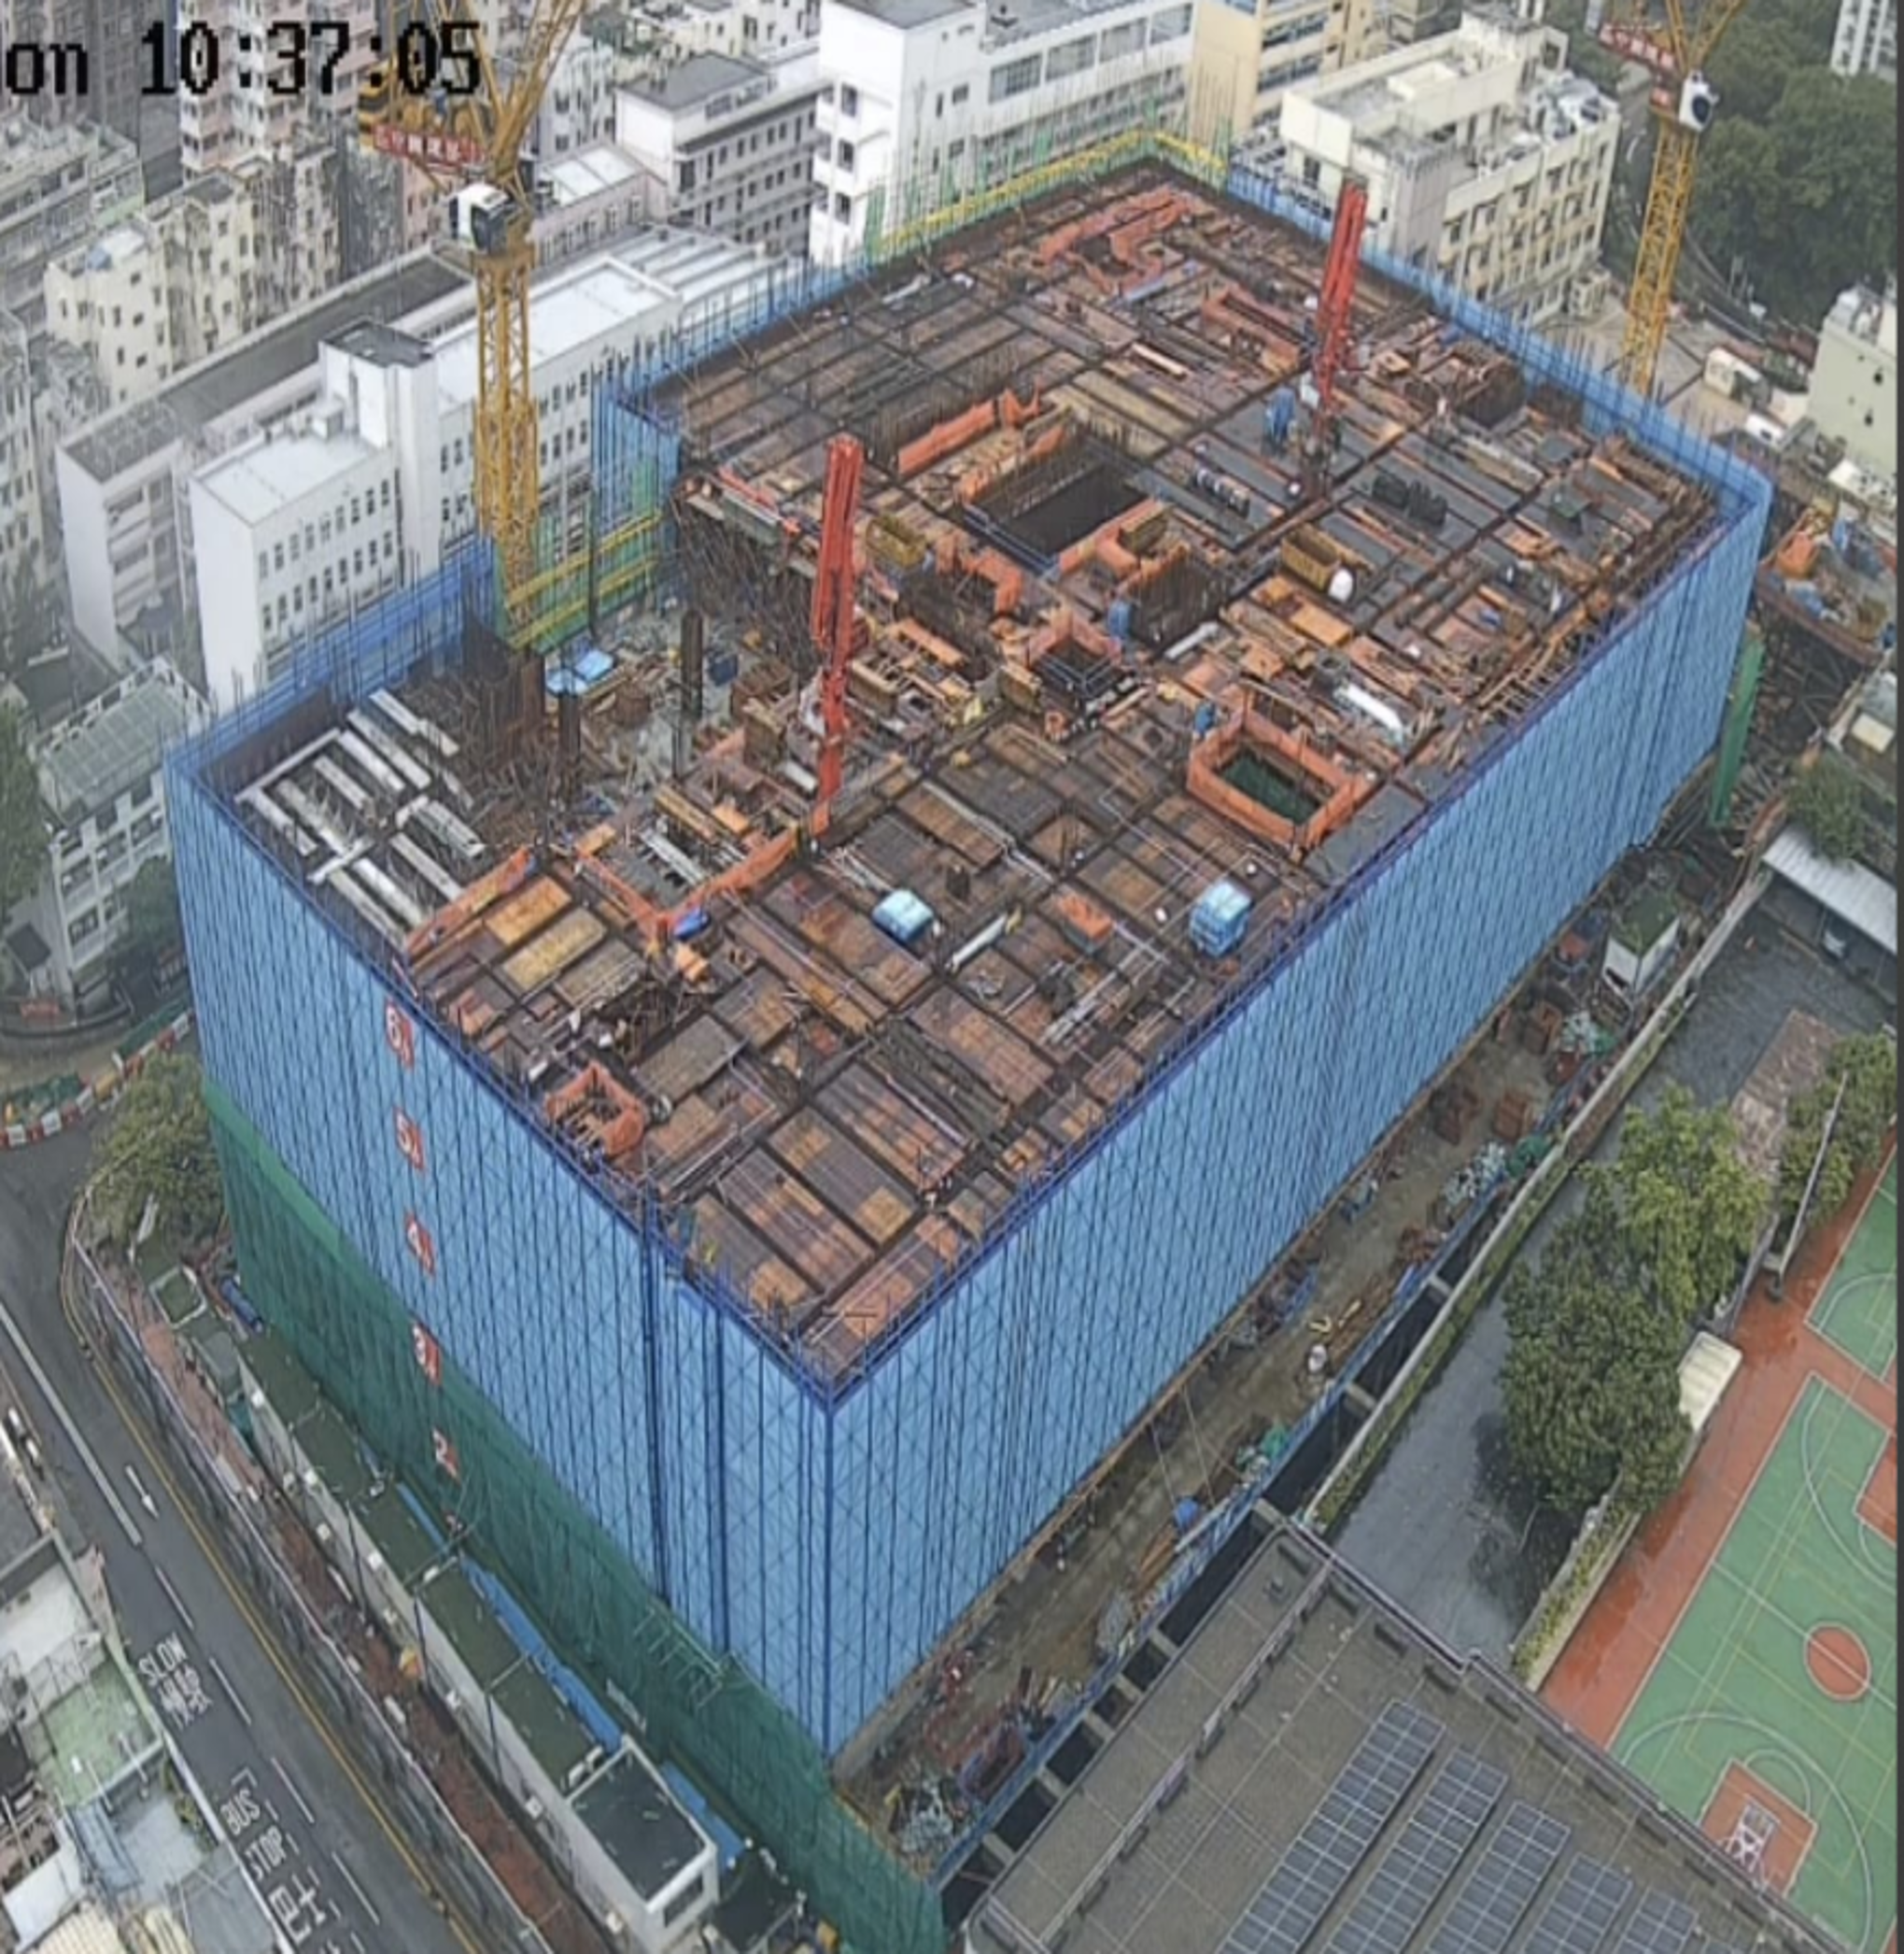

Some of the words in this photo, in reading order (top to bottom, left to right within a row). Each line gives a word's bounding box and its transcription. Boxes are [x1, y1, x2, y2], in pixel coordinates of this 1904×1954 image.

[139, 1631, 187, 1687] SLOW
[220, 1788, 261, 1835] BUS
[244, 1825, 287, 1881] STOP
[268, 1873, 326, 1944] 巴士
